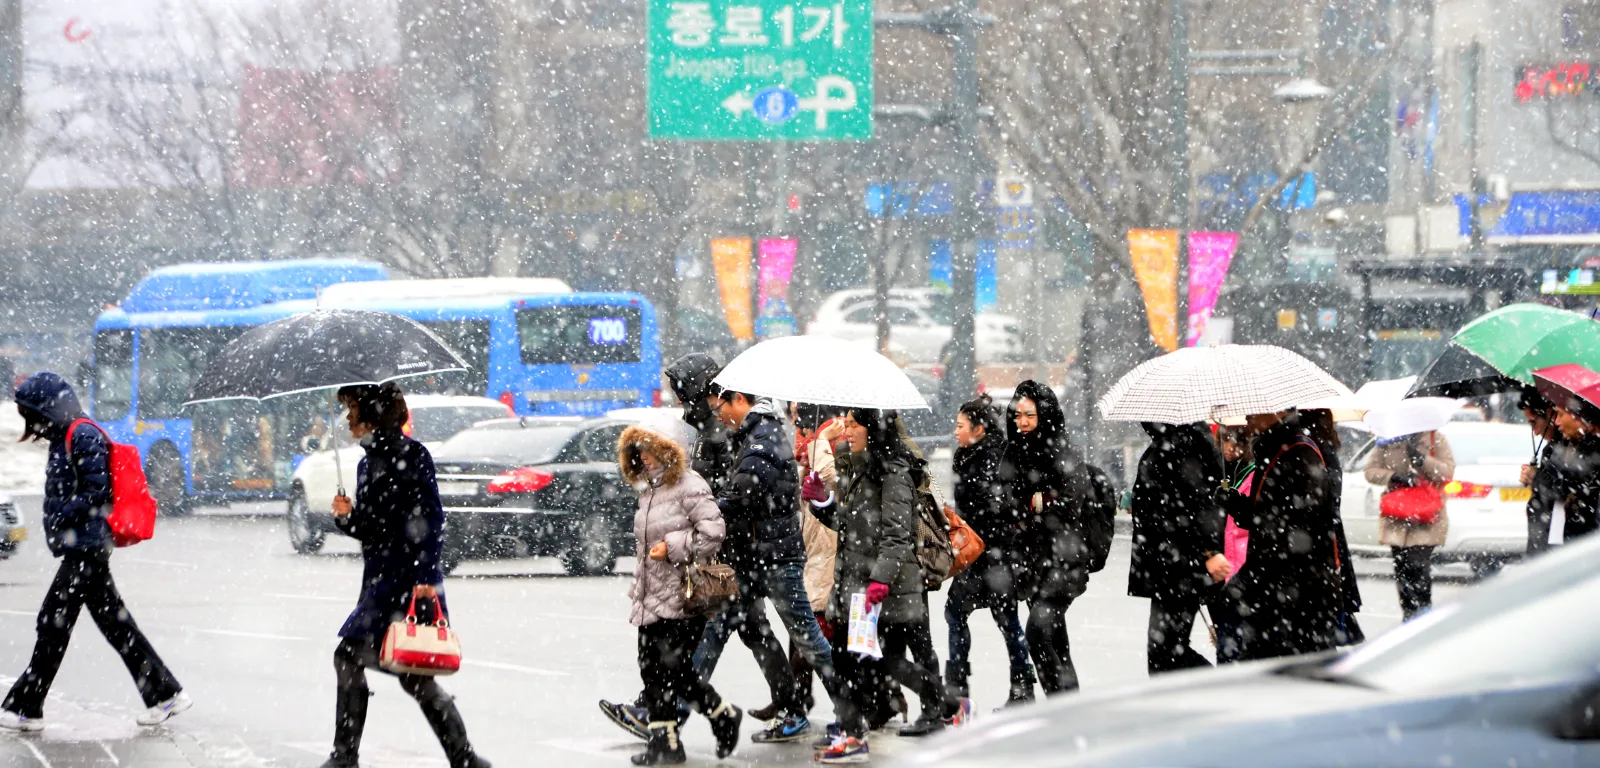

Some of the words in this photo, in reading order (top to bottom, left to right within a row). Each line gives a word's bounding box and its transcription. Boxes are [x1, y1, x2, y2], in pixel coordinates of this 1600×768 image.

[666, 2, 850, 48] 종로1가
[766, 92, 785, 118] 6
[591, 319, 625, 341] 700
